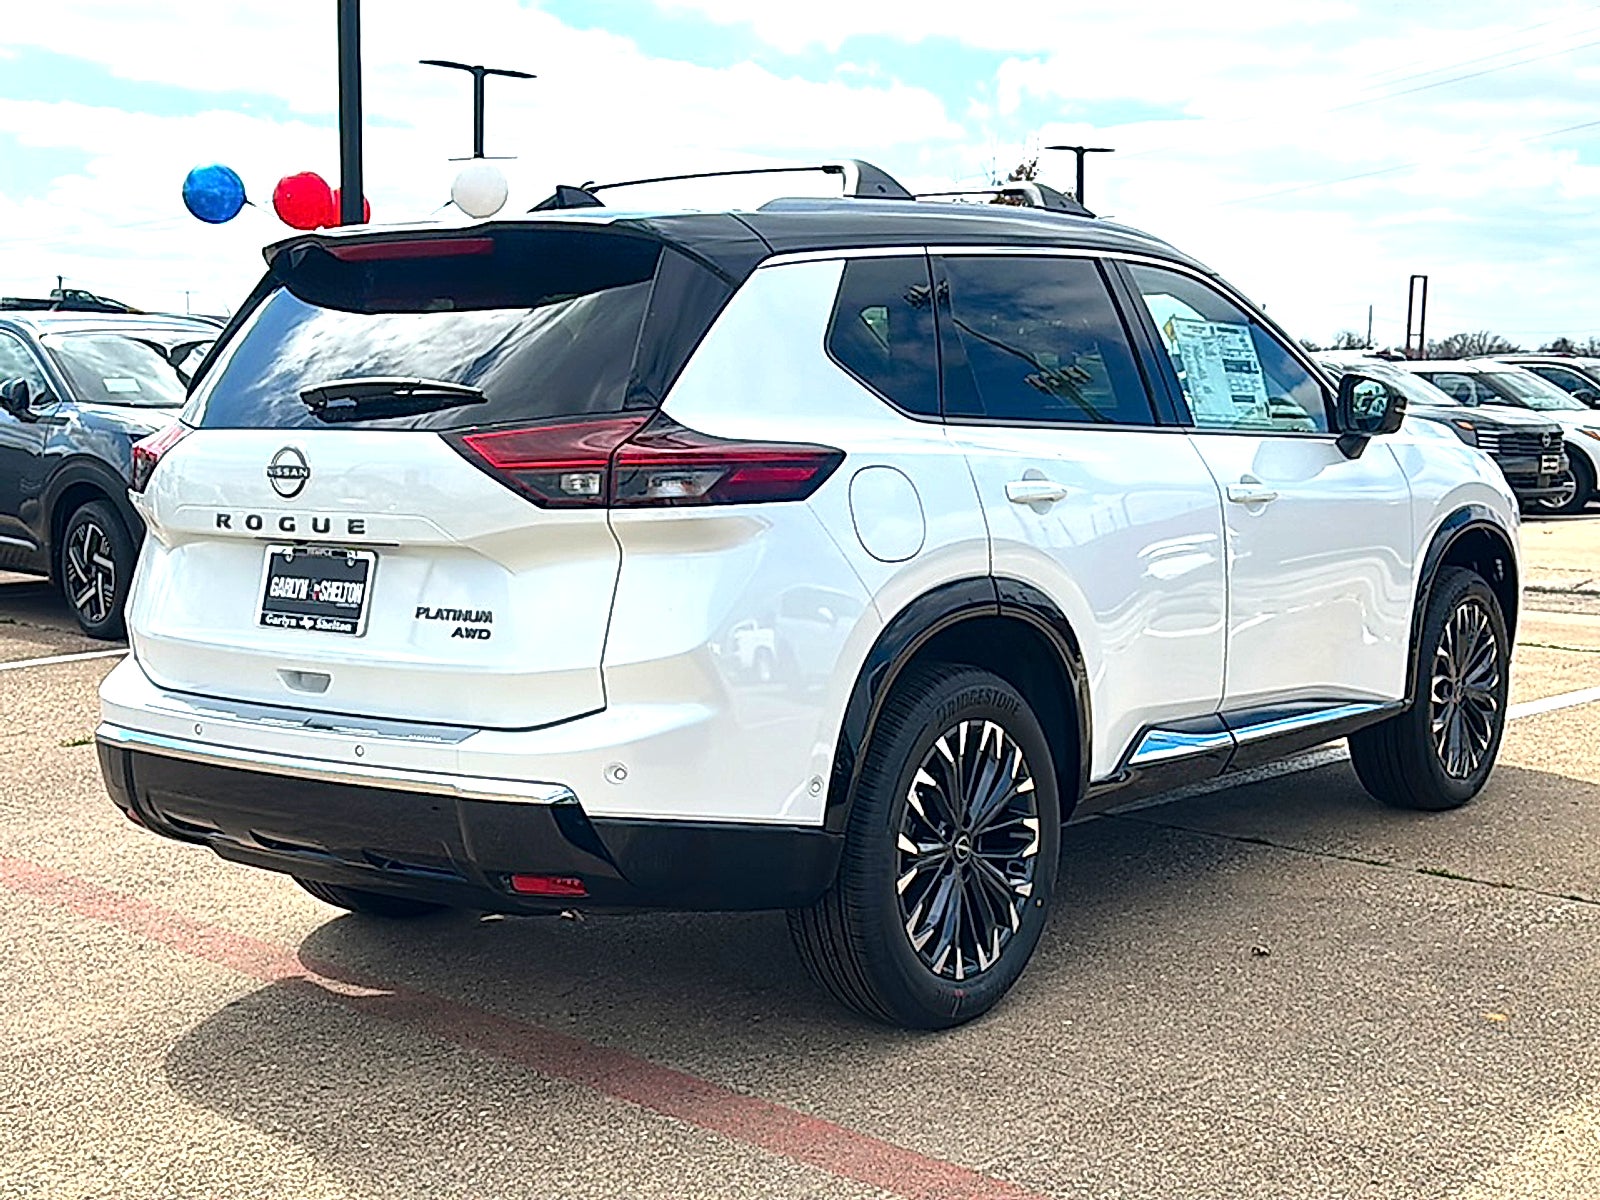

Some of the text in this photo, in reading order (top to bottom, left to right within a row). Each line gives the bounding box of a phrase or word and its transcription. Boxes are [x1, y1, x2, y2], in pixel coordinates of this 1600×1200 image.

[267, 467, 308, 477] NISSAN
[216, 513, 365, 535] ROGUE
[269, 576, 364, 604] GARLYN SHELTON
[265, 613, 297, 628] Garlyn
[415, 606, 493, 624] PLATINUM
[451, 627, 491, 640] AWD
[936, 688, 1021, 723] BRIDGESTONE
